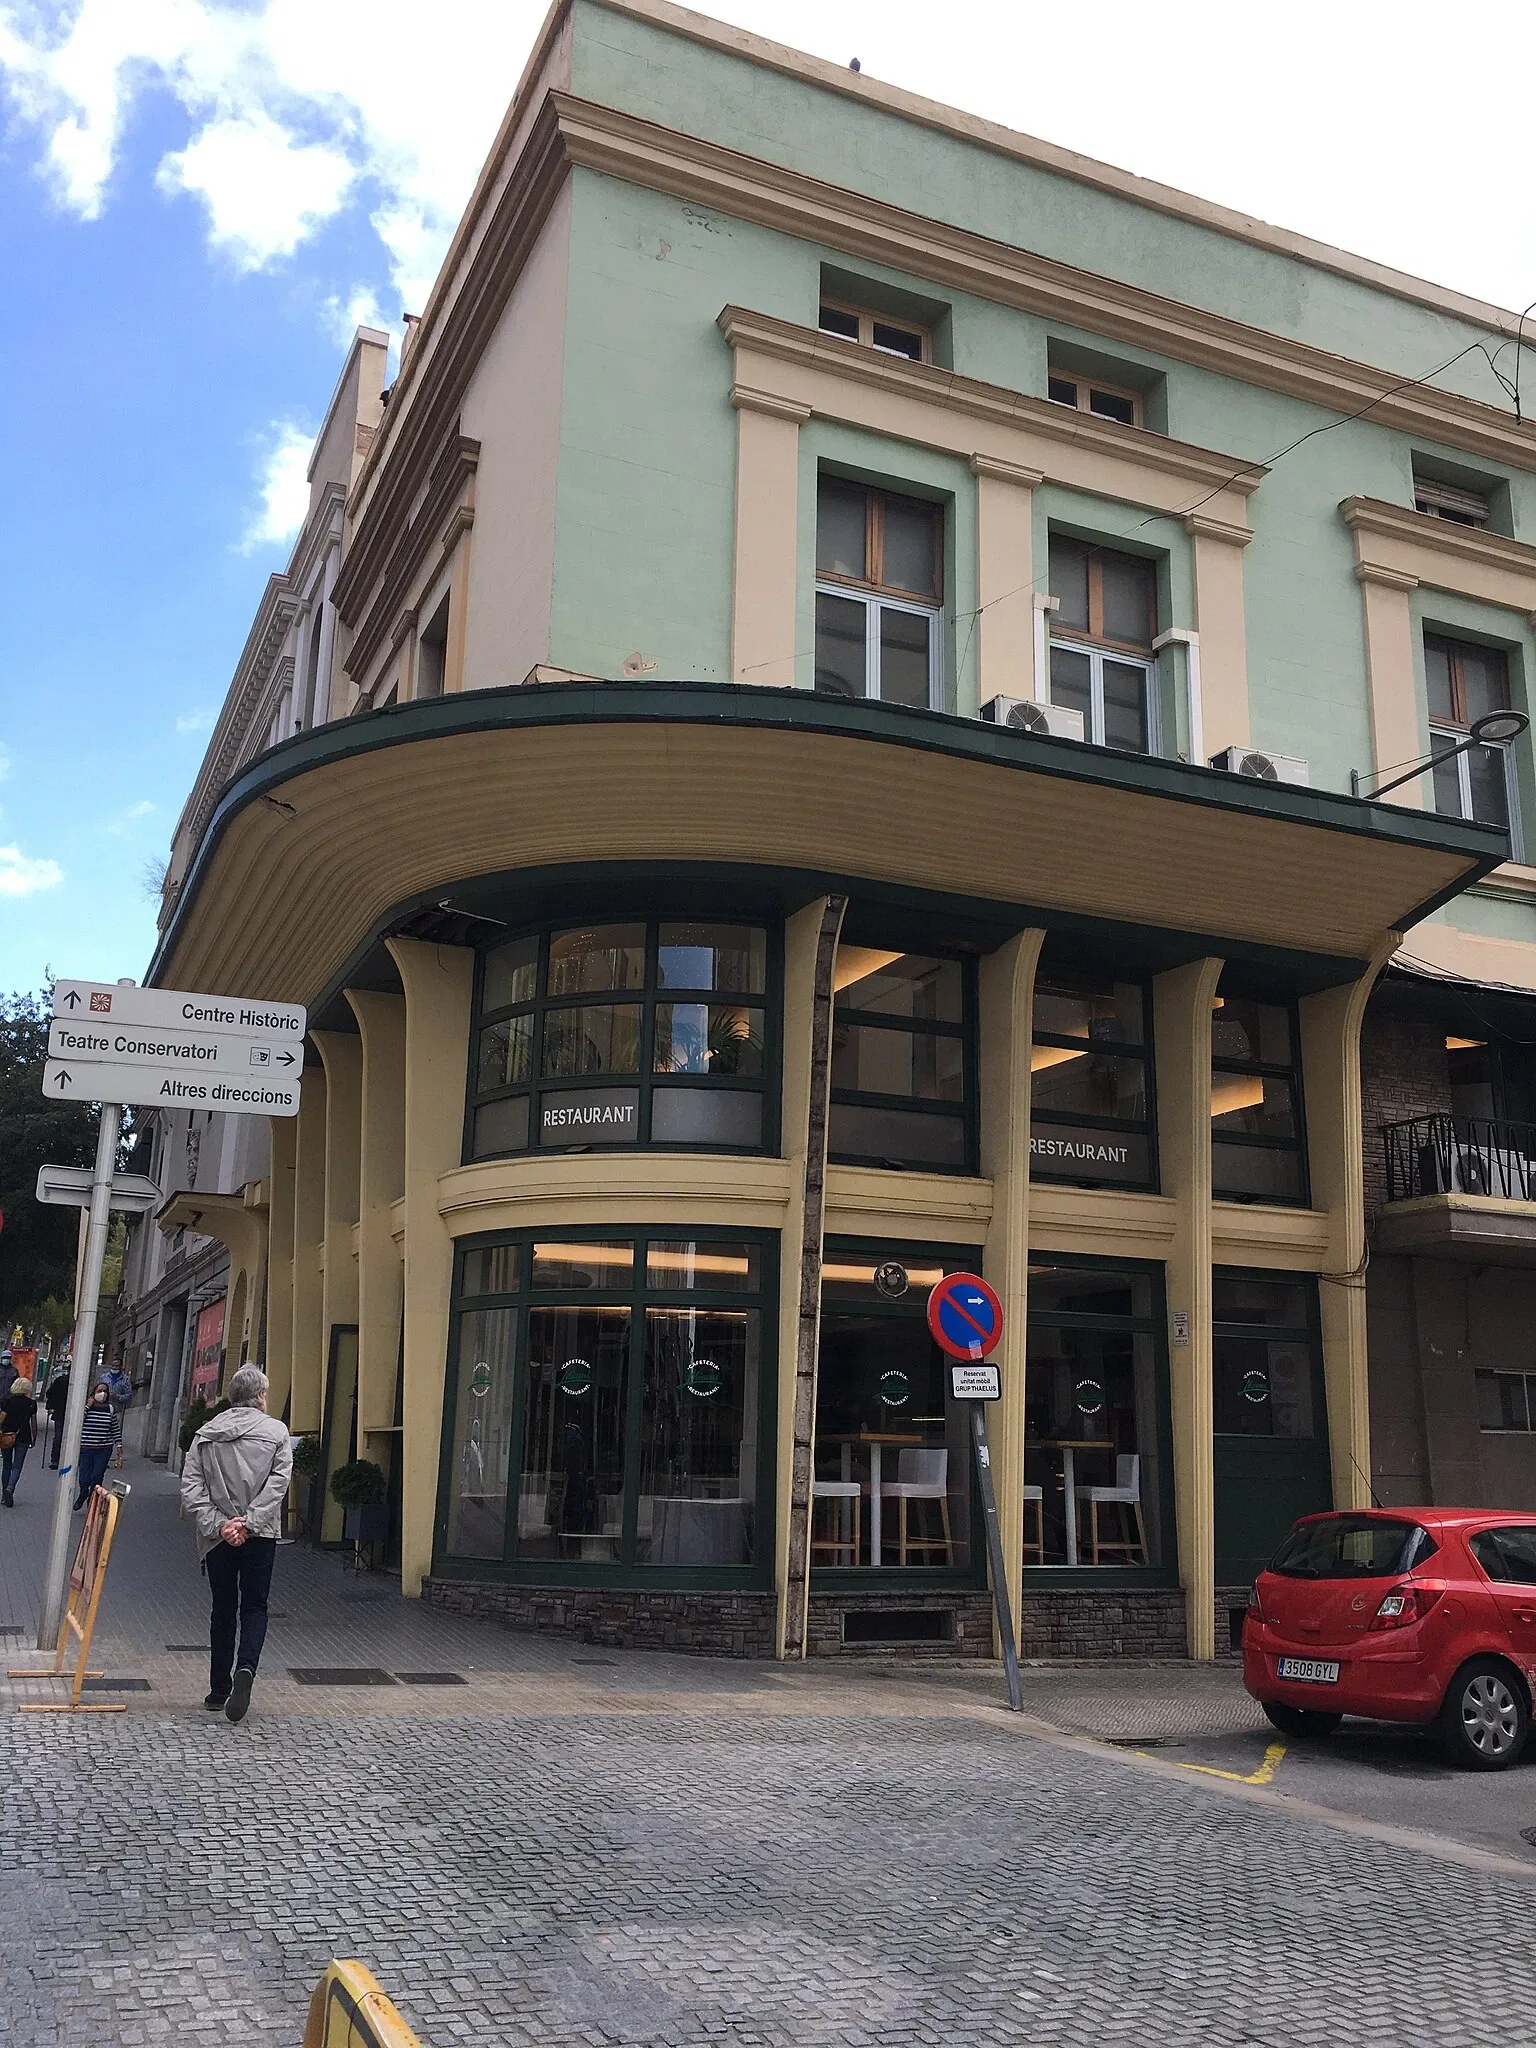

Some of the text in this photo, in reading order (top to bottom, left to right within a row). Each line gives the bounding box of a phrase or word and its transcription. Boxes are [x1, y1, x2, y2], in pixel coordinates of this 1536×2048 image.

[182, 1003, 300, 1031] Centre Històric
[58, 1031, 218, 1061] Teatre Conservatori
[160, 1079, 293, 1106] Altres direccions
[543, 1106, 634, 1127] RESTAURANT
[1029, 1138, 1128, 1163] RESTAURANT
[561, 1359, 591, 1369] CAFETERIA
[687, 1360, 720, 1370] CAFETERIA
[1285, 1660, 1335, 1680] 3508 GYL
